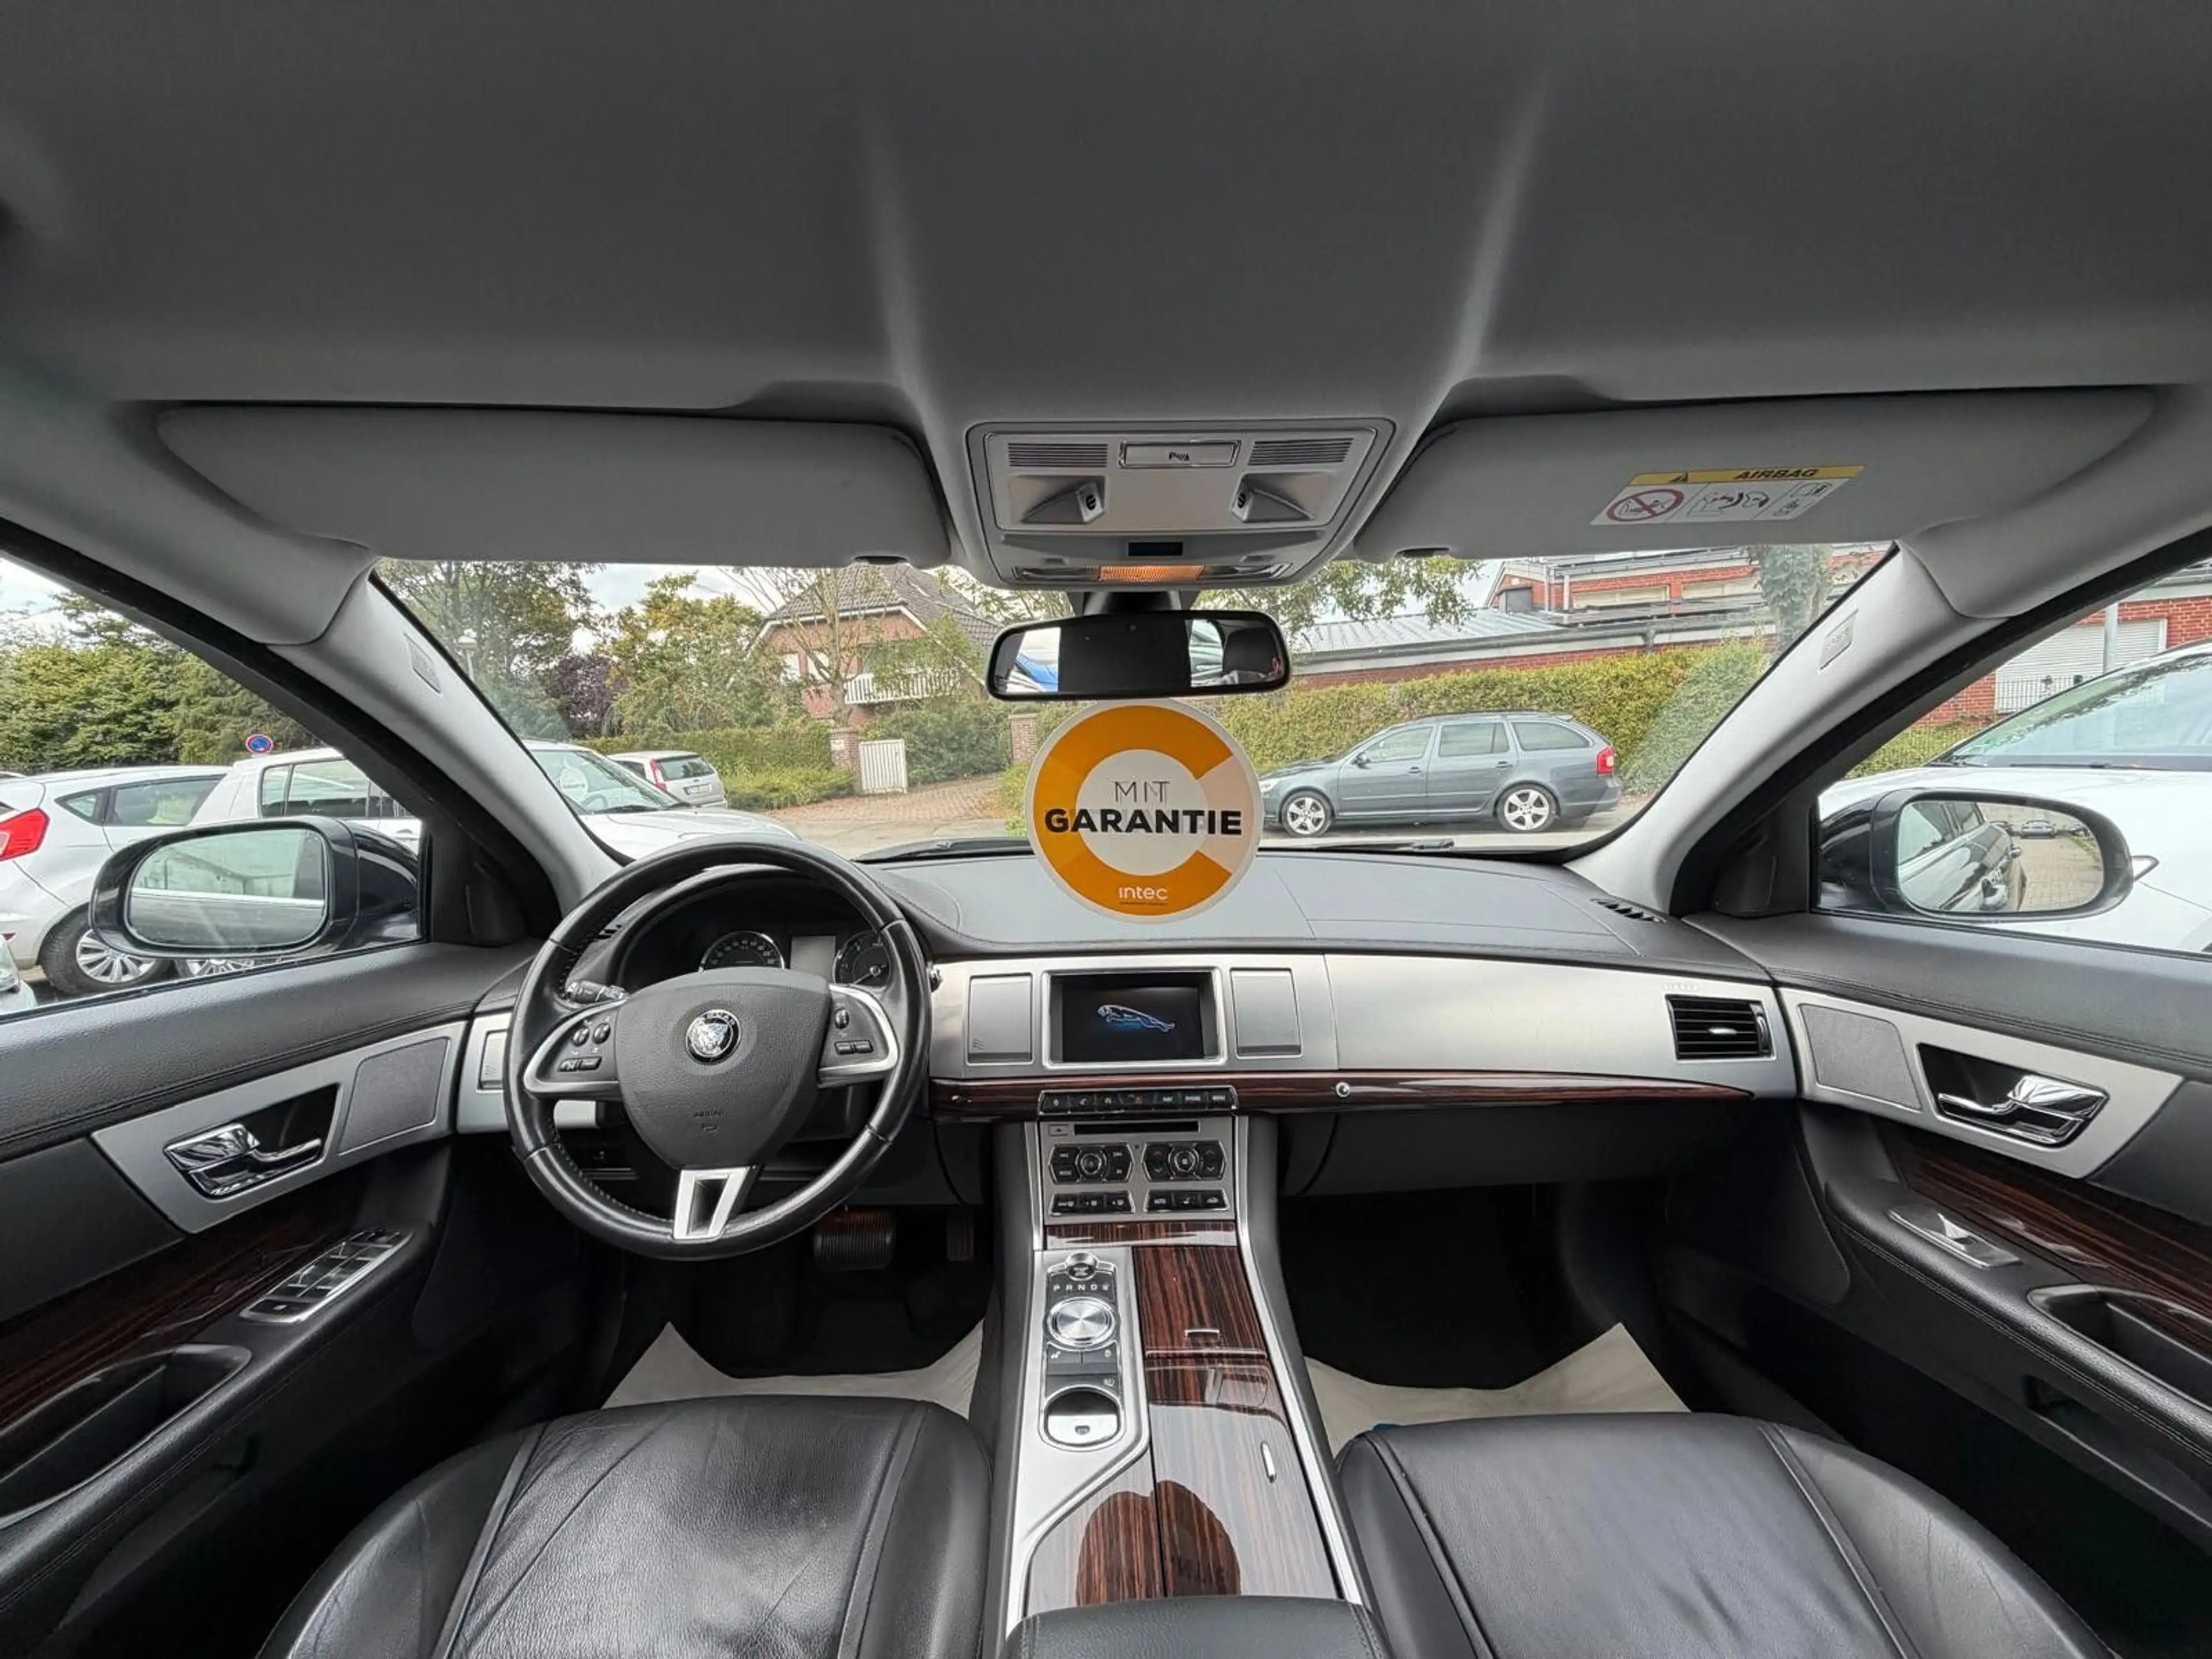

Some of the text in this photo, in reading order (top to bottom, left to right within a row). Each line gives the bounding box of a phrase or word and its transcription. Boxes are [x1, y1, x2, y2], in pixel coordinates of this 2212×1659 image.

[1733, 468, 1819, 480] AIRBAG
[1115, 781, 1170, 803] MIT
[1044, 809, 1242, 835] GARANTIE
[1118, 886, 1168, 900] intec
